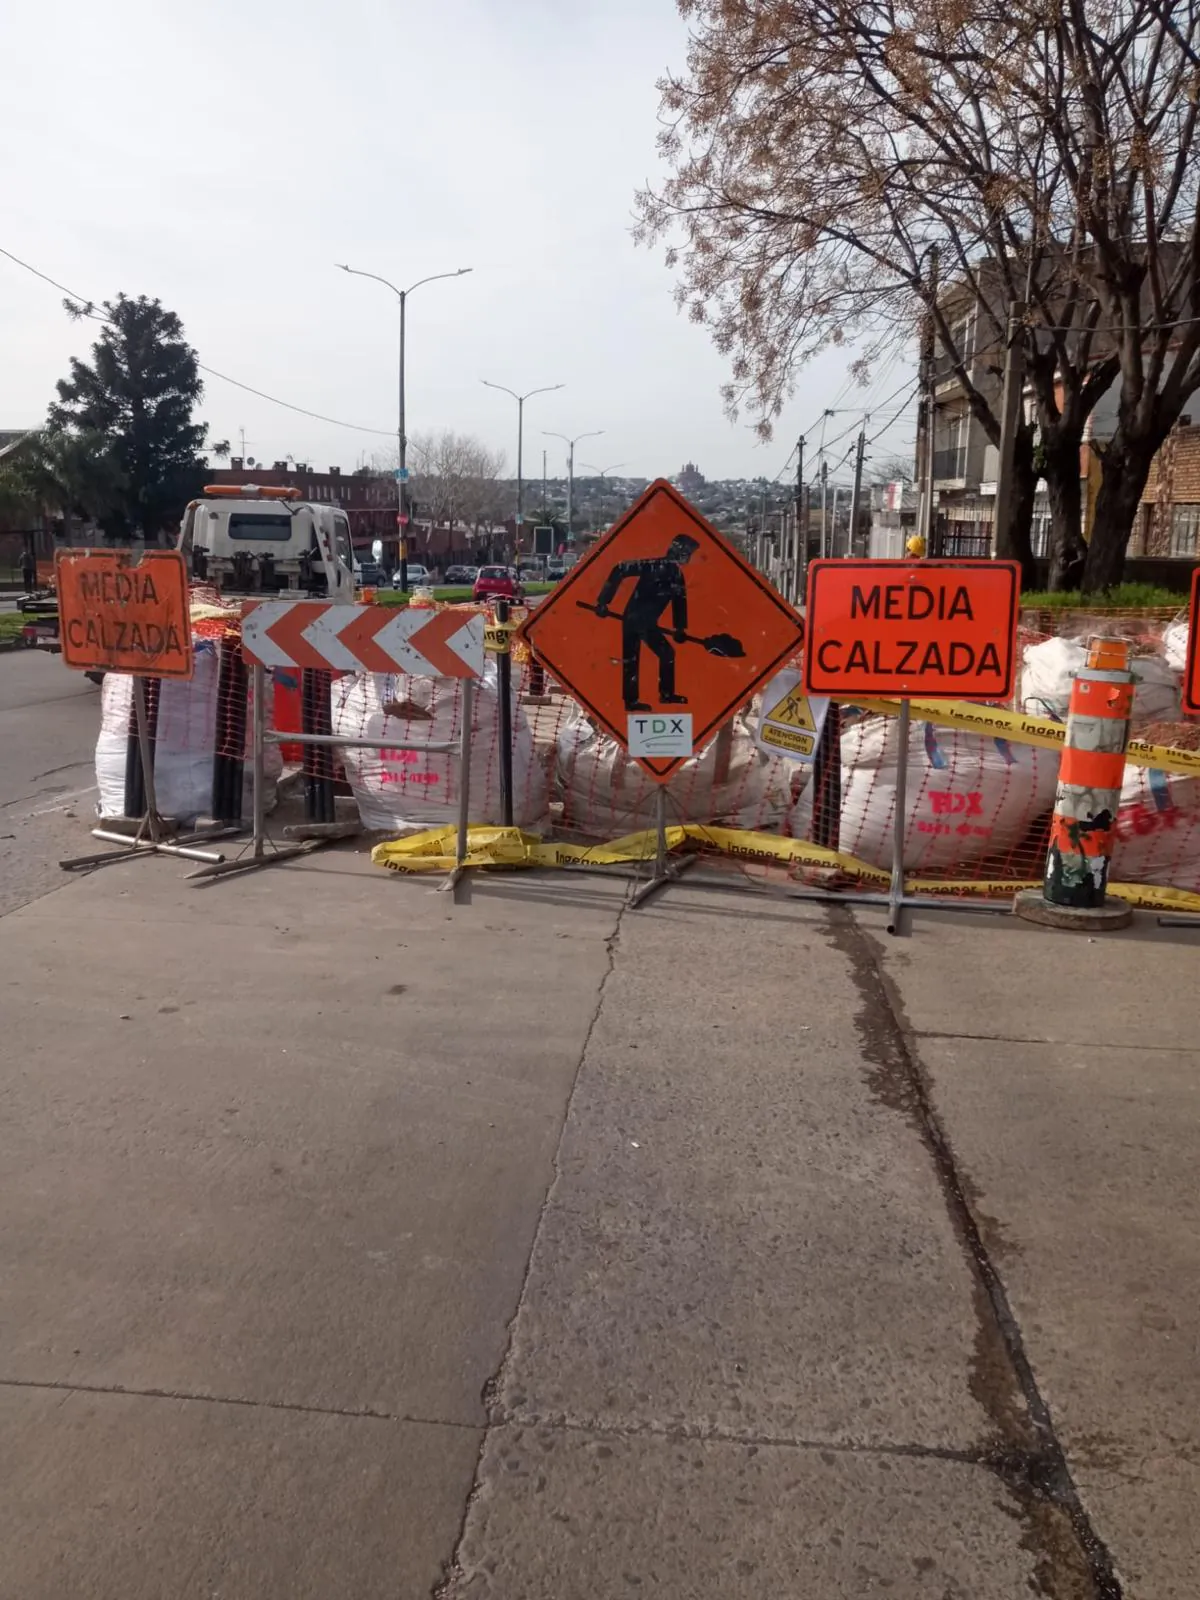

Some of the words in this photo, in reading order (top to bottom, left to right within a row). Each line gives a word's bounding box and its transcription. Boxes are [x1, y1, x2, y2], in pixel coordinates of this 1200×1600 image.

[79, 570, 159, 605] MEDIA
[851, 585, 974, 621] MEDIA
[67, 617, 183, 656] CALZADA
[817, 639, 1002, 678] CALZADA
[634, 719, 684, 734] TDX
[928, 791, 984, 817] TDX
